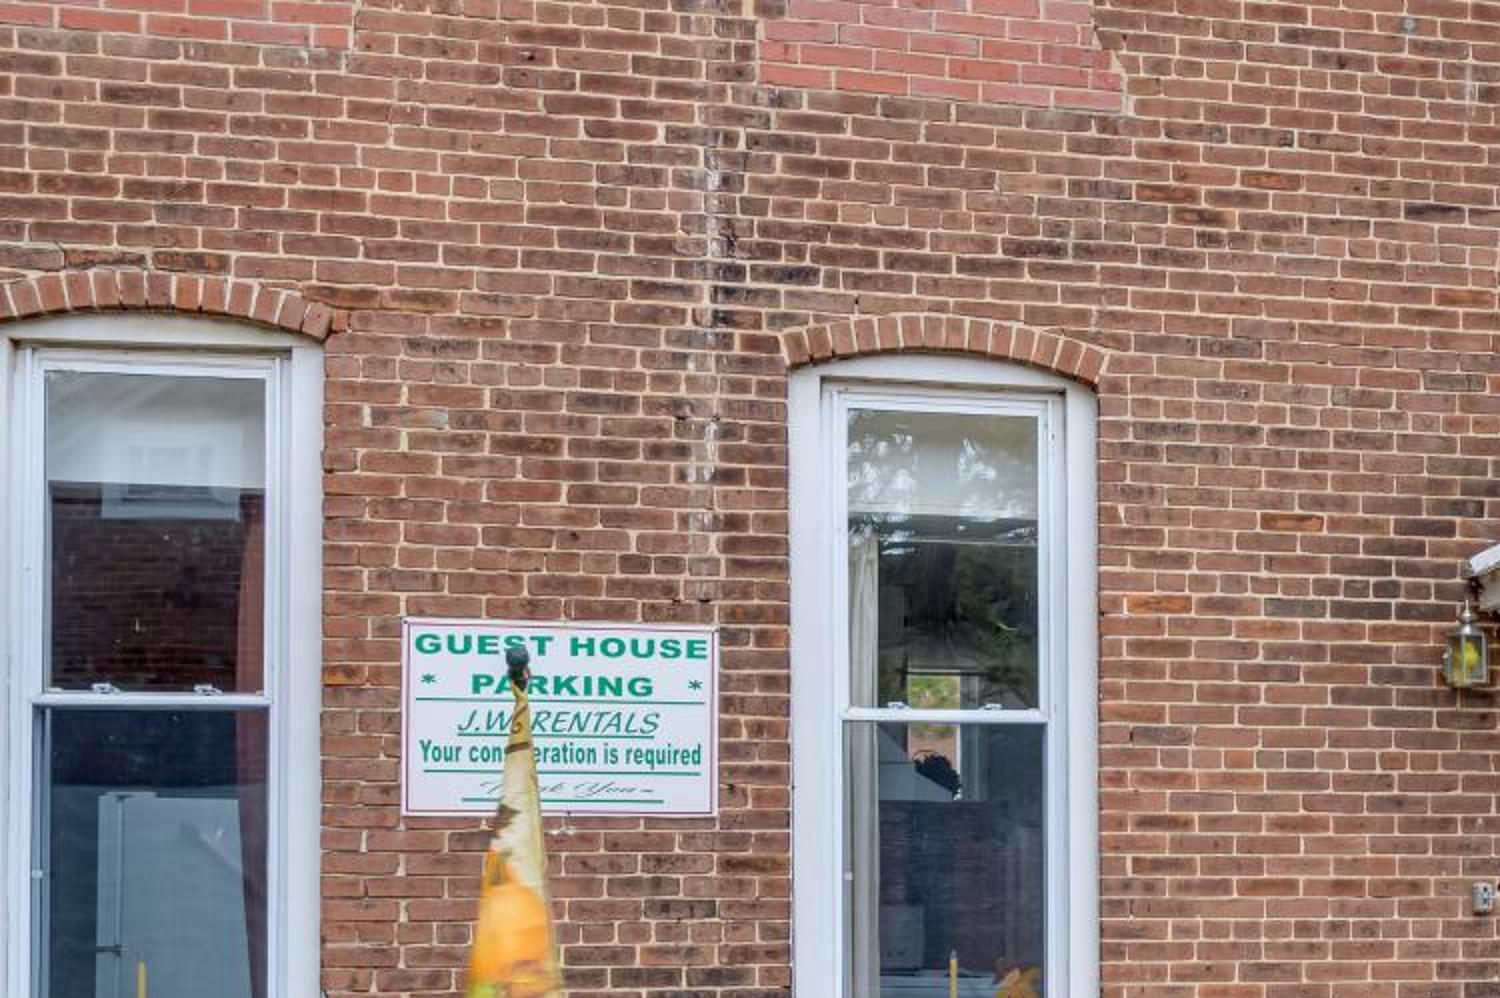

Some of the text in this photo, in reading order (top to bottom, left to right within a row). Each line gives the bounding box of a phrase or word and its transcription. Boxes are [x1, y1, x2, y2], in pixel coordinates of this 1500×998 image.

[415, 633, 707, 659] GUEST HOUSE
[471, 673, 653, 697] PARKING
[531, 711, 660, 734] RENTALS
[419, 739, 702, 770] Your coneration is required
